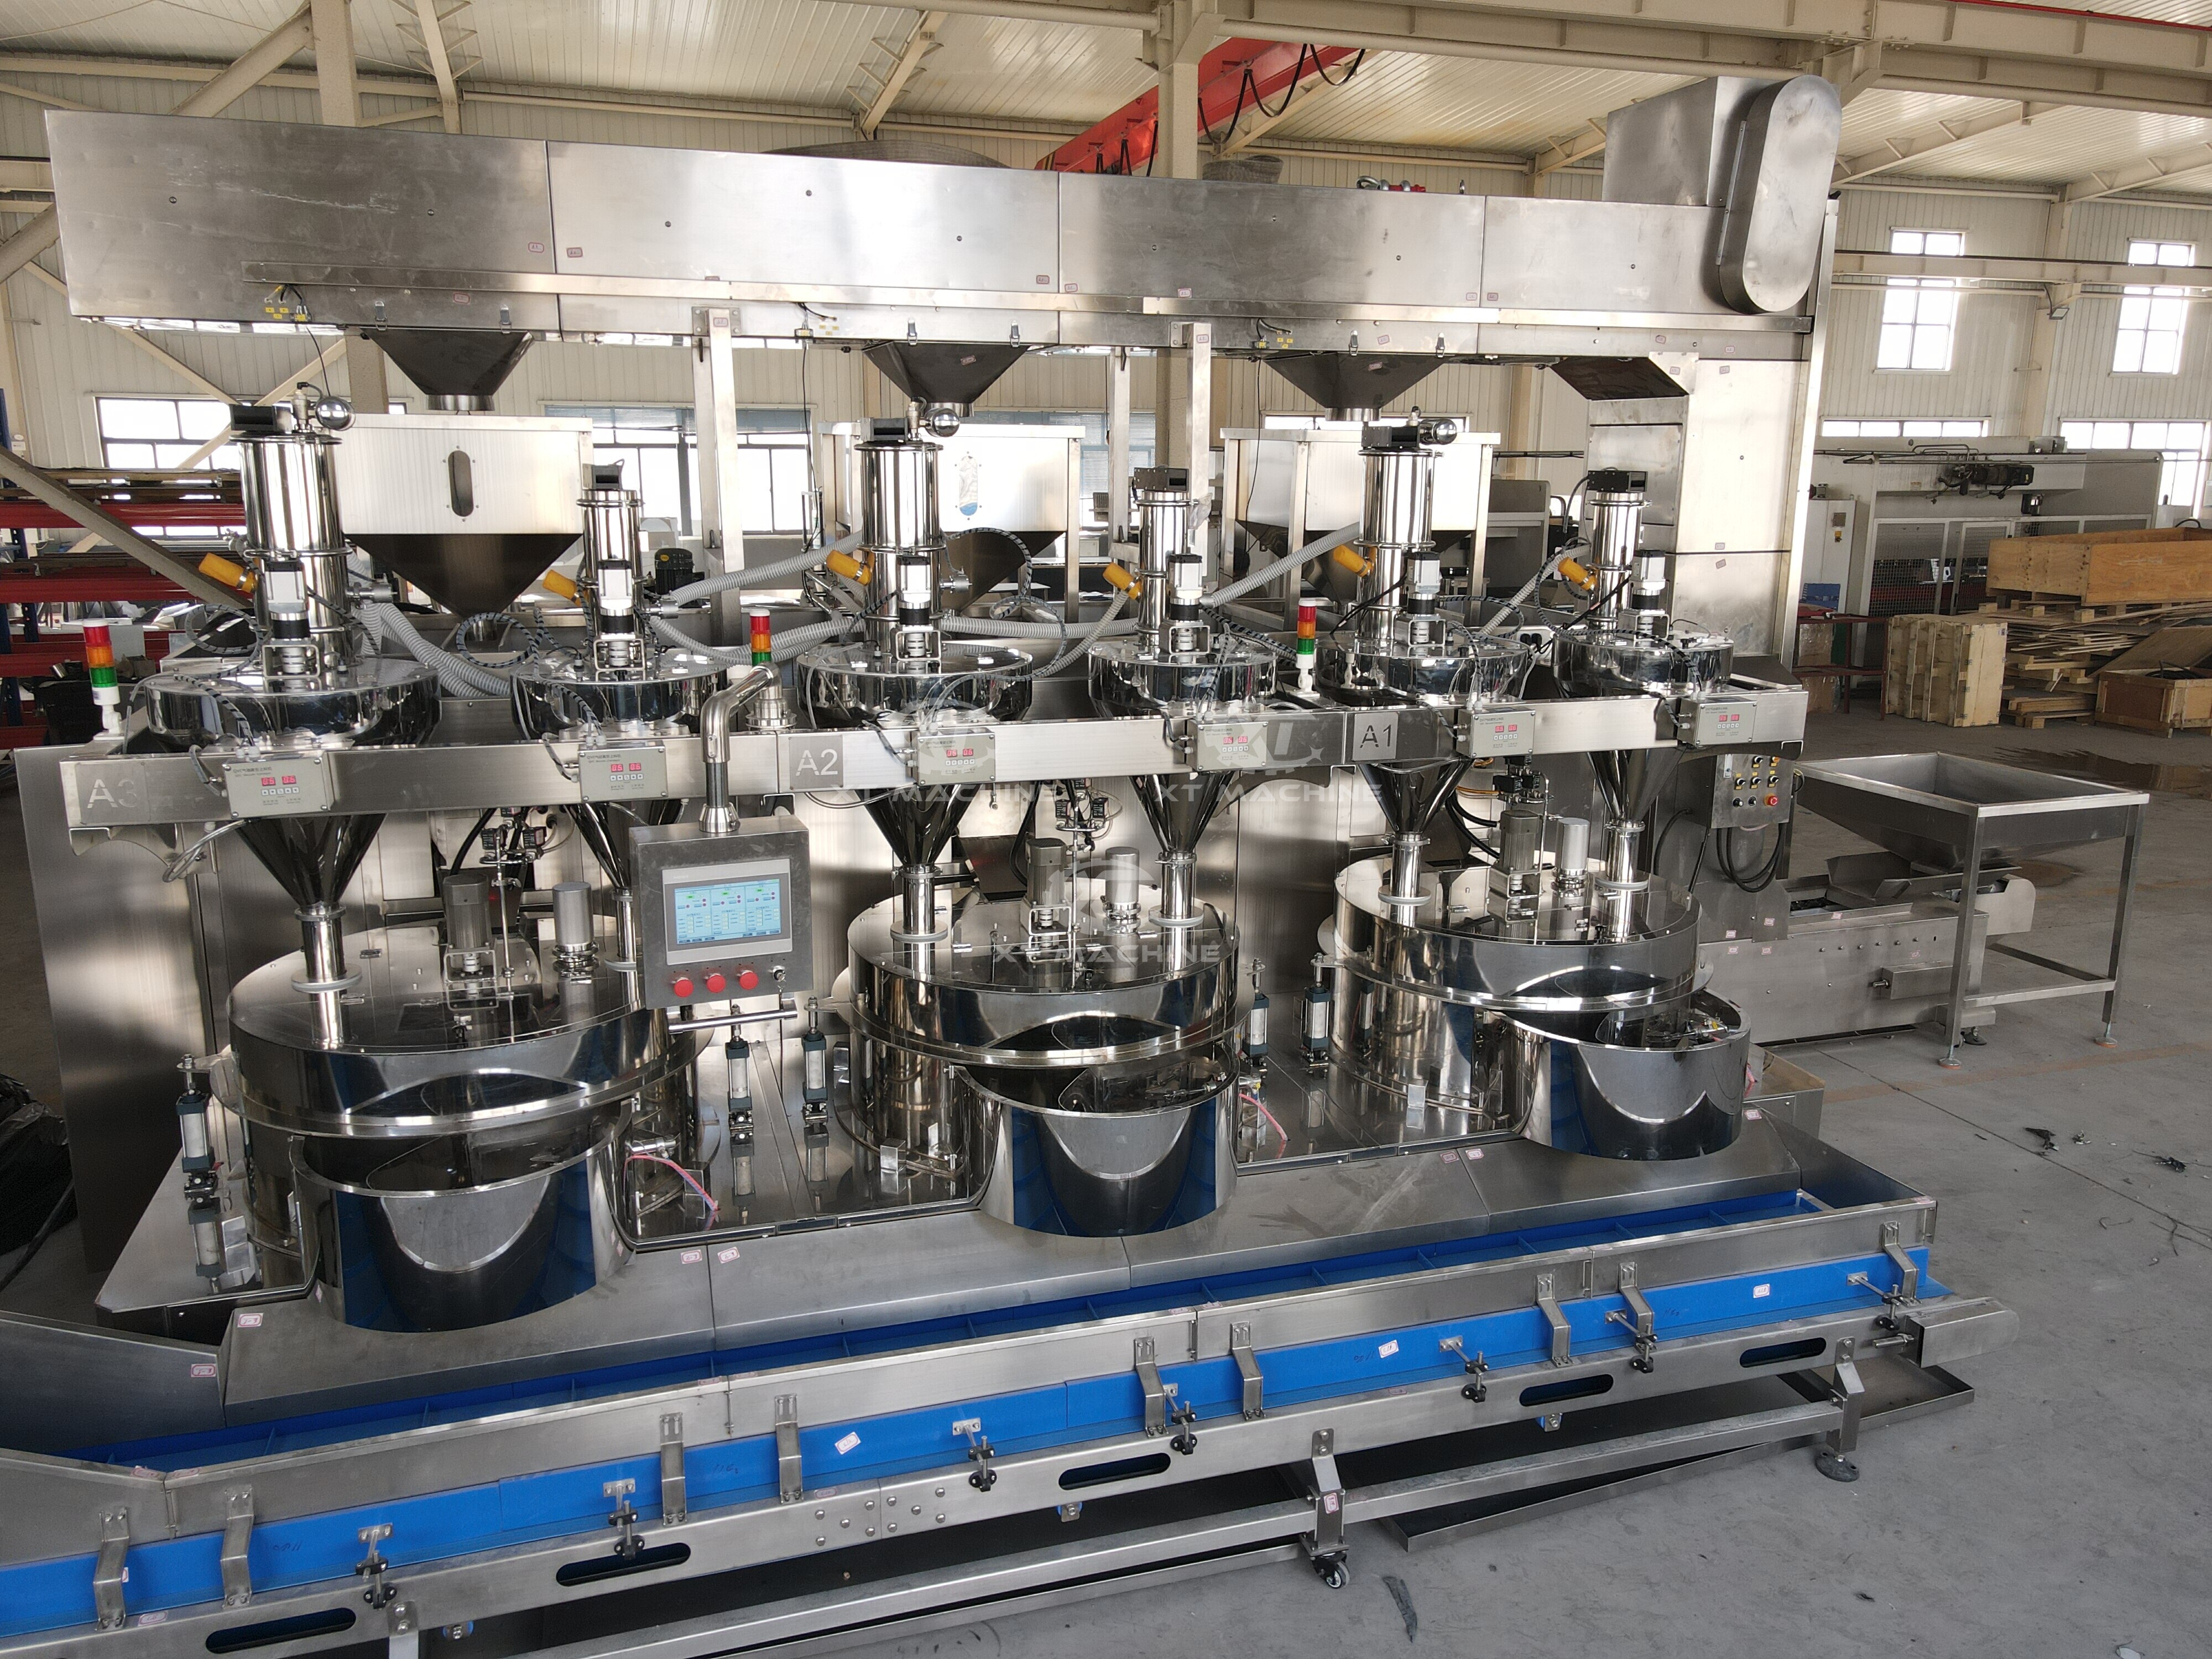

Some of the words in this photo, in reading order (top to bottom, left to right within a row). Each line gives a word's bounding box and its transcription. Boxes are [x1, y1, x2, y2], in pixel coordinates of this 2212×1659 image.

[1359, 724, 1391, 748] A1
[796, 749, 838, 776] A2
[87, 778, 138, 809] A3
